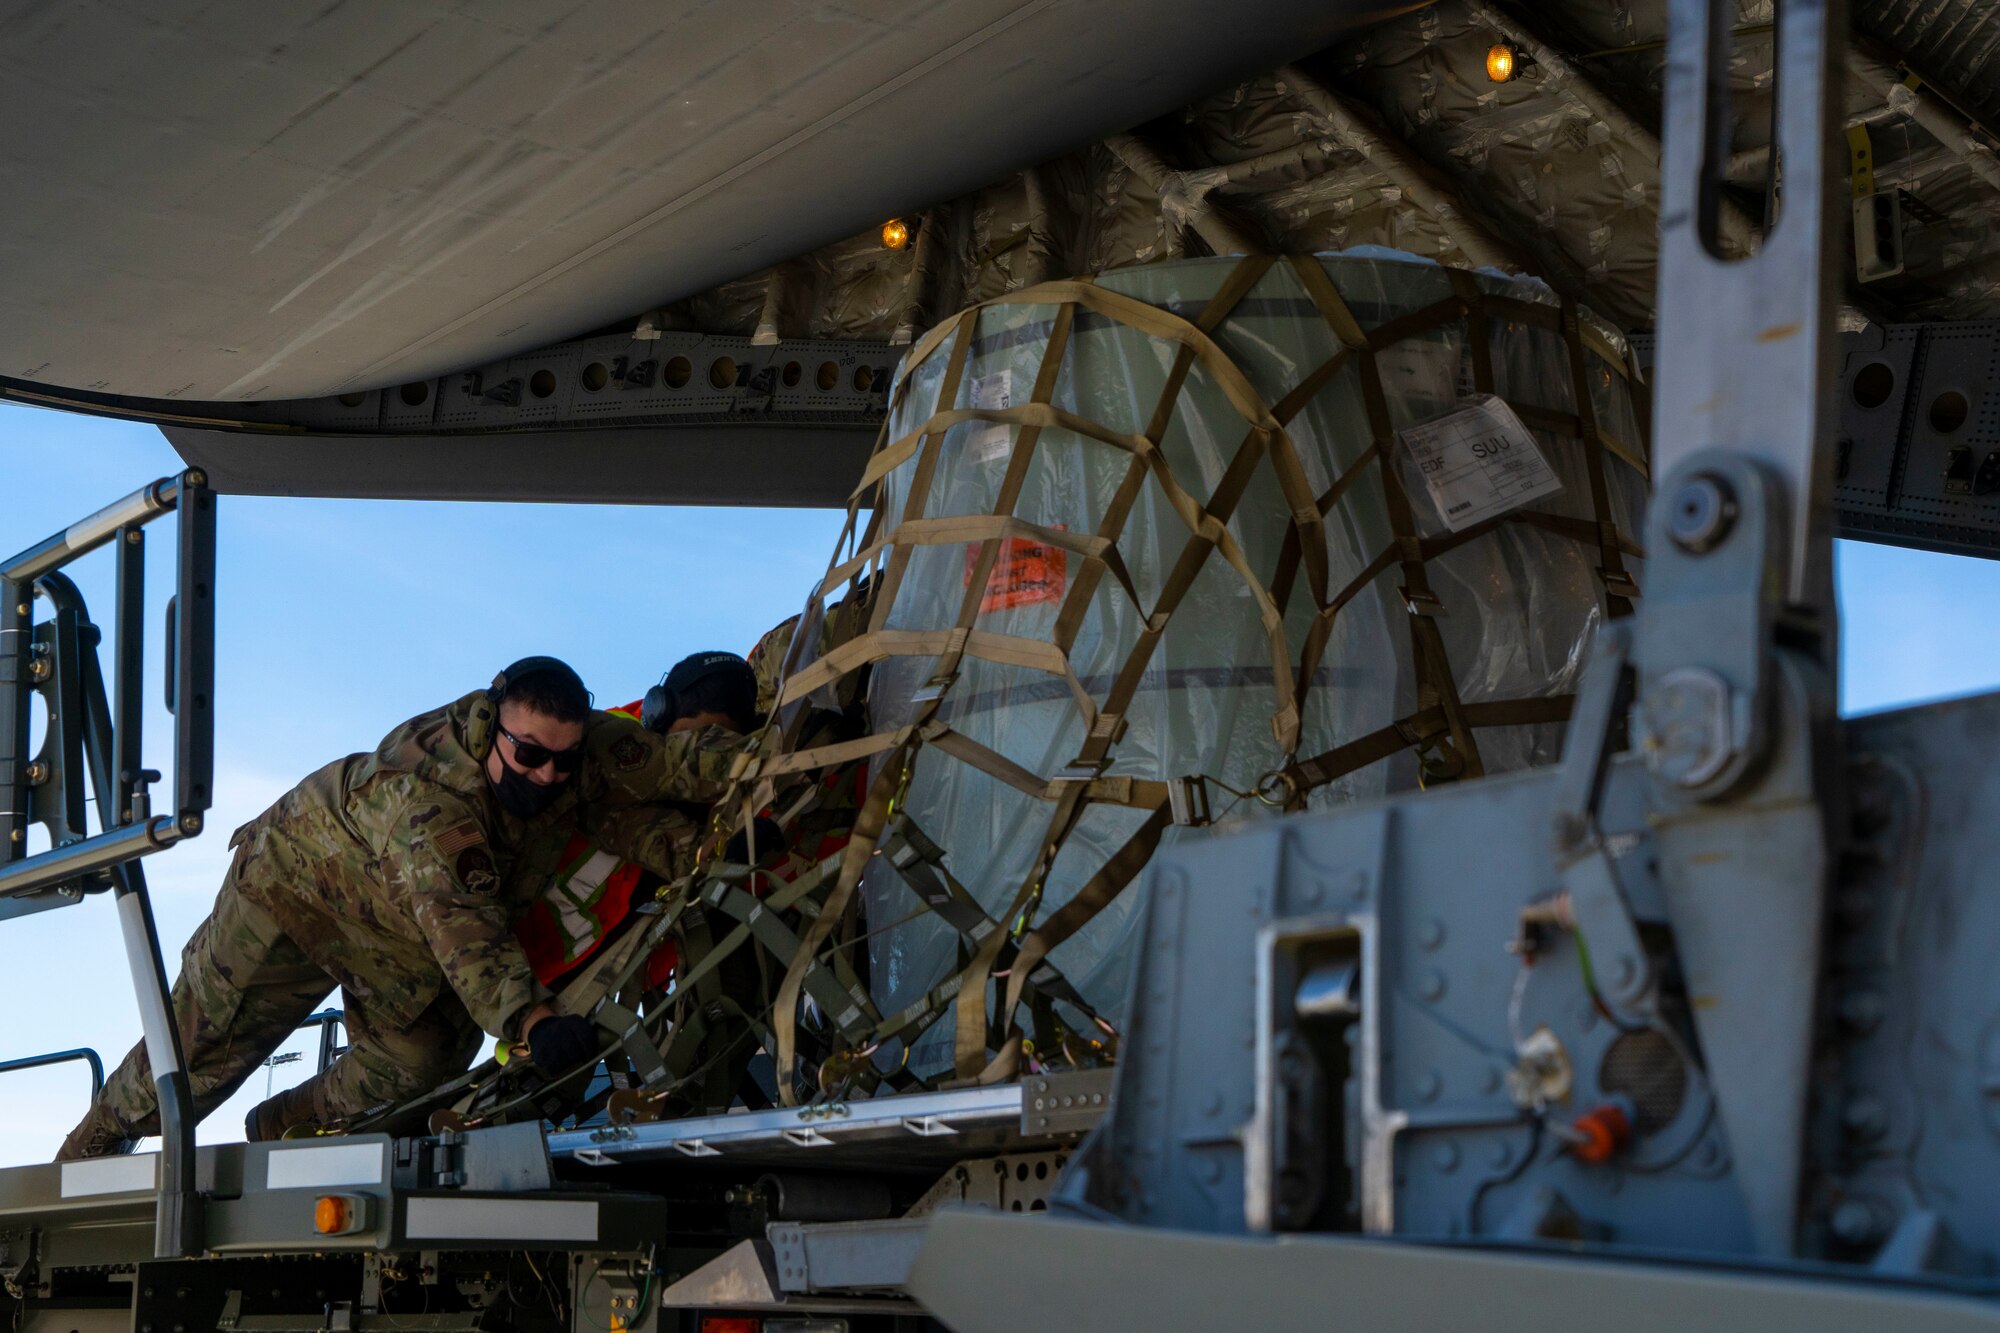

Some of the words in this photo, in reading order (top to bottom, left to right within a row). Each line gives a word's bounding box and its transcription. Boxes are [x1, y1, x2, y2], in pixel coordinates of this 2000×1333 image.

[839, 356, 856, 367] 1700
[1472, 435, 1510, 458] SUU
[1420, 456, 1445, 473] EDF
